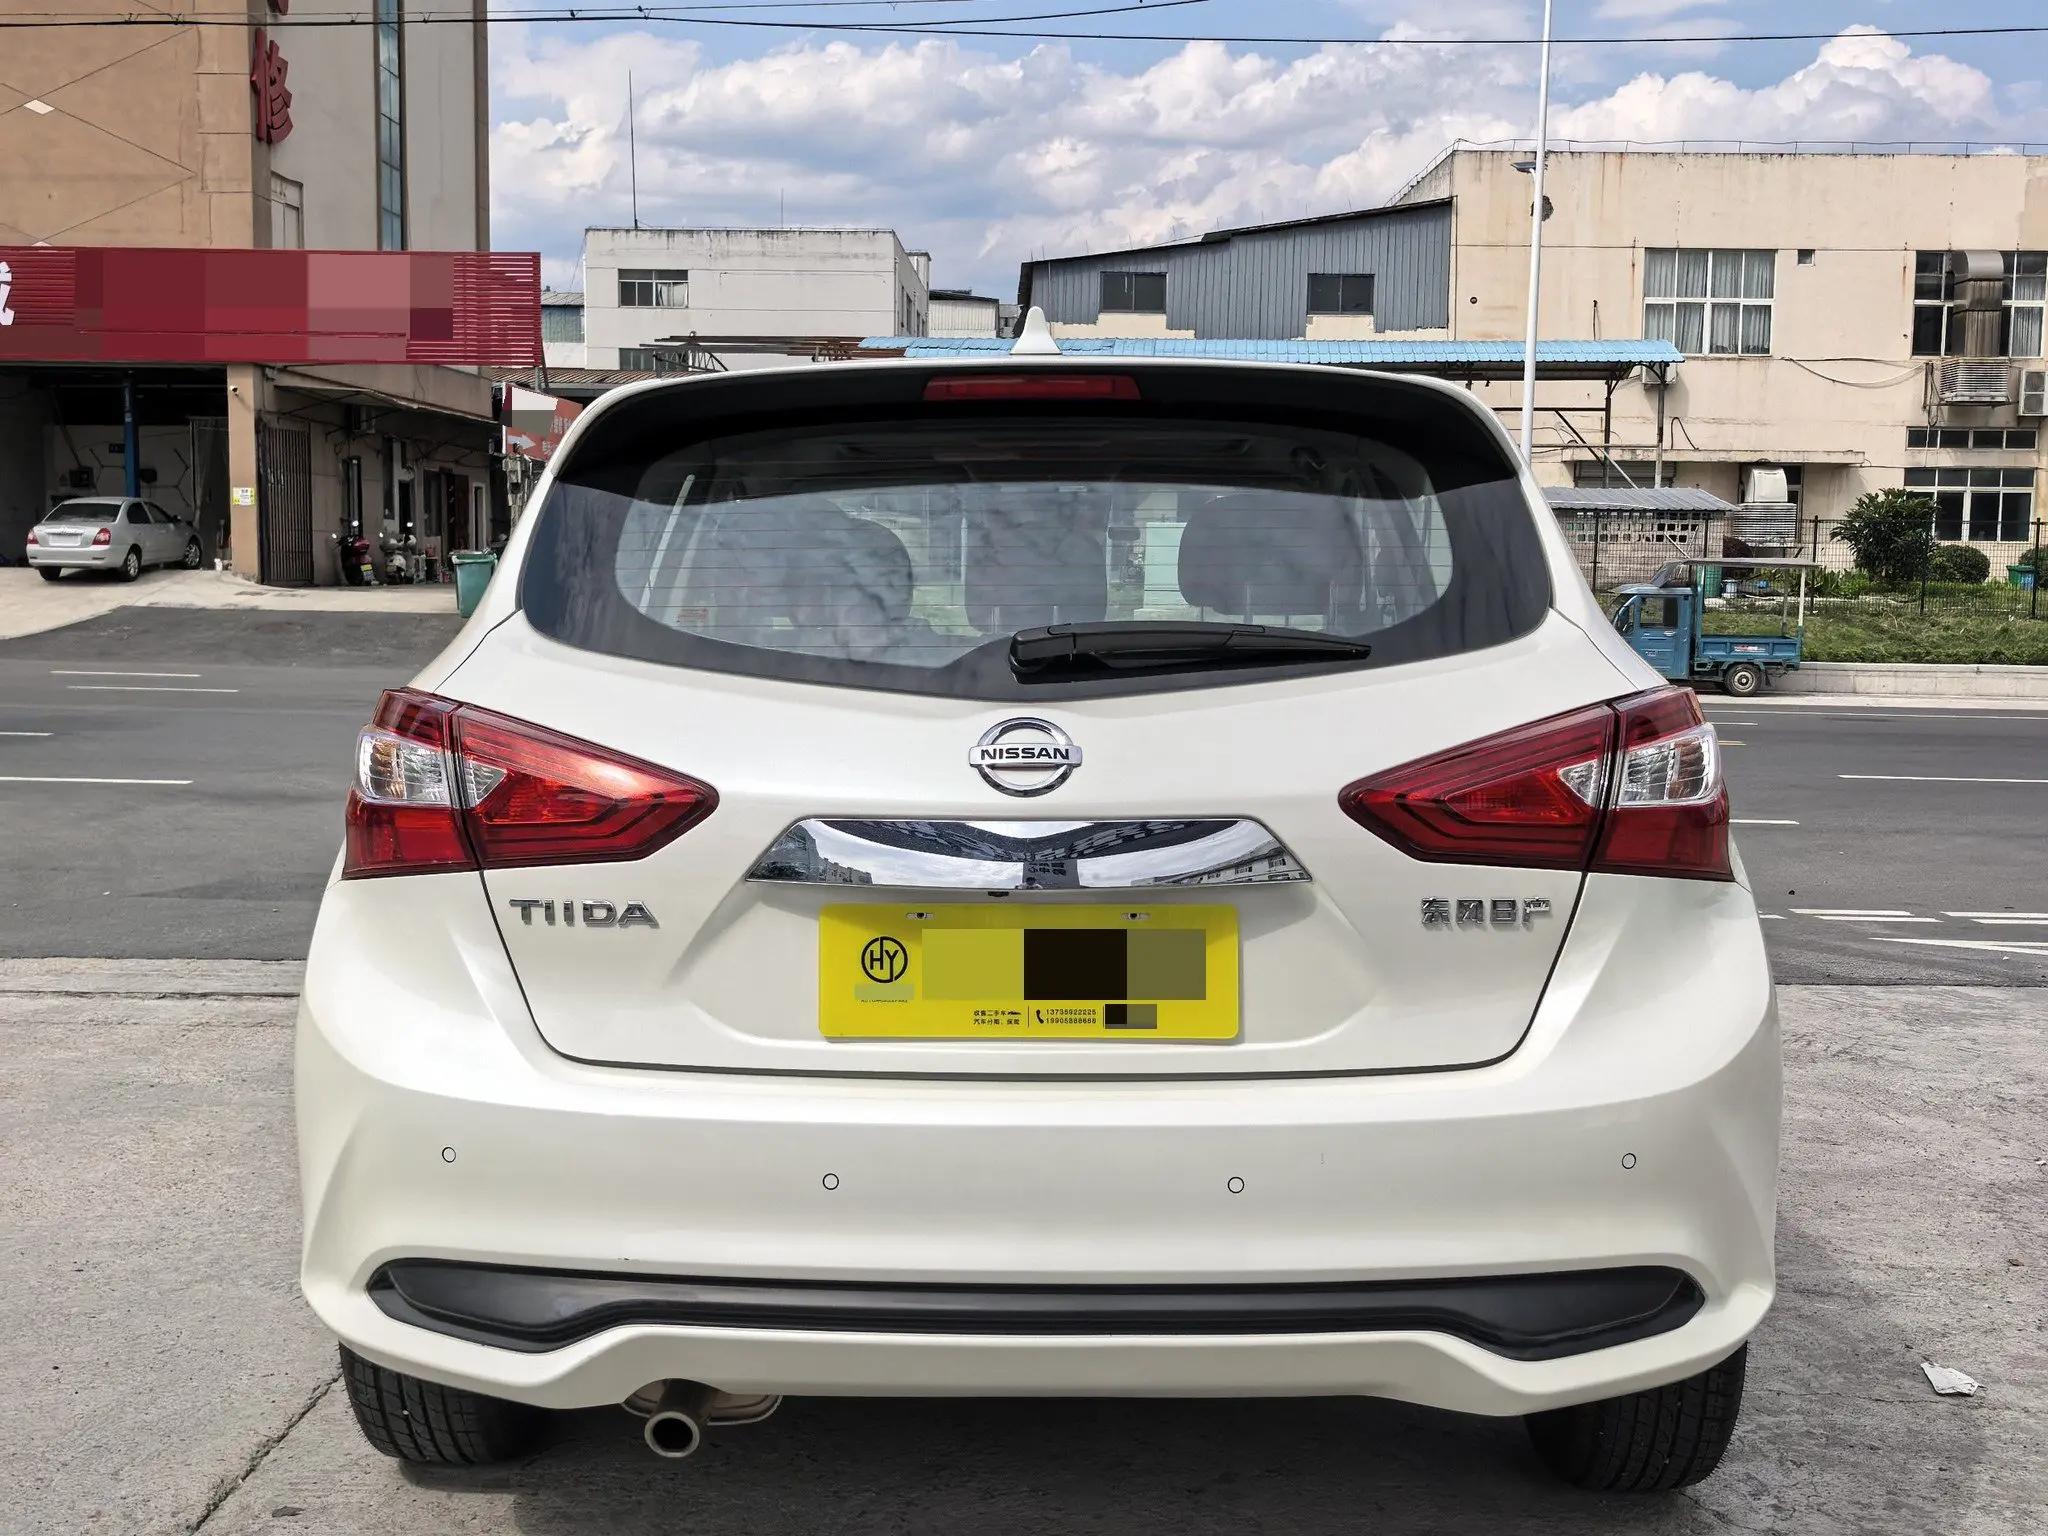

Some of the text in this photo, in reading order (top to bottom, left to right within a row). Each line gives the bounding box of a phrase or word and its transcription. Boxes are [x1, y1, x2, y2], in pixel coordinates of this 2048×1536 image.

[250, 0, 294, 145] 修
[980, 747, 1070, 761] NISSAN
[508, 898, 660, 927] TIIDA
[1421, 897, 1552, 925] 东风日产
